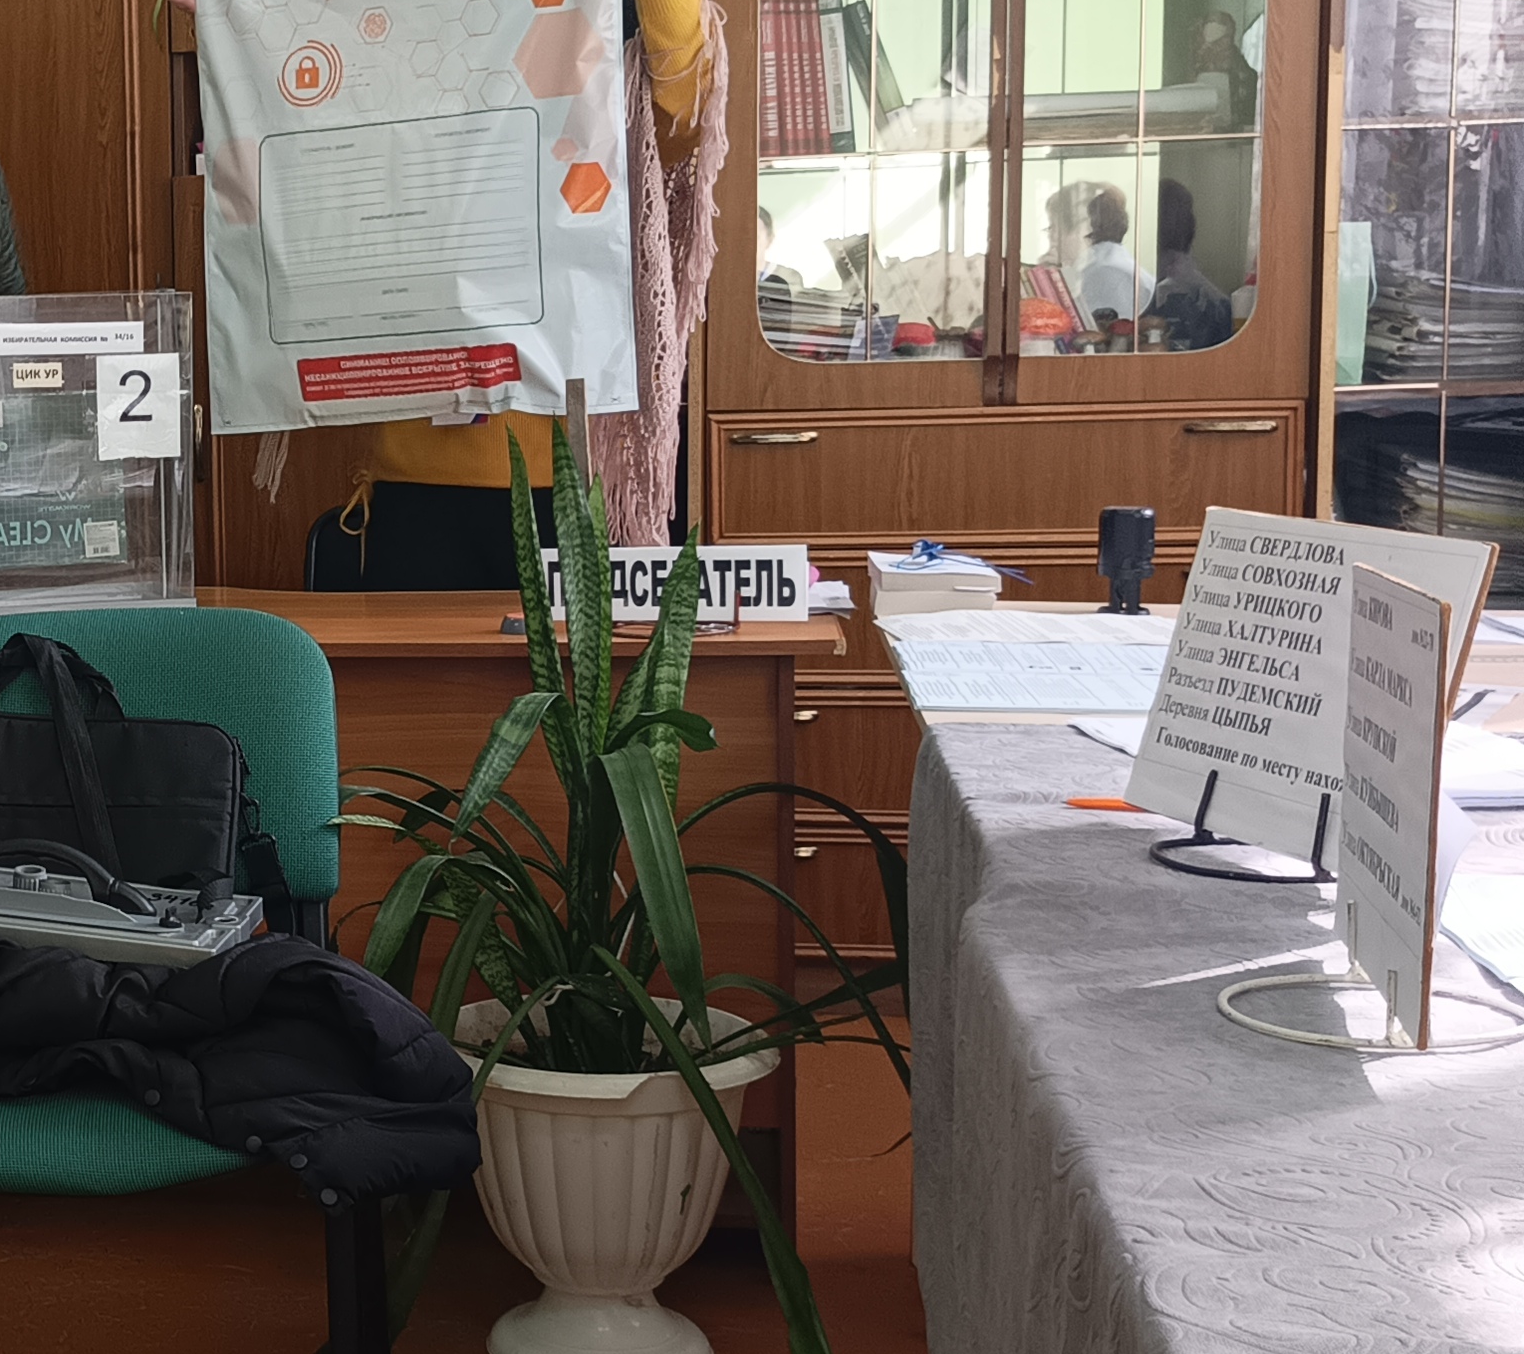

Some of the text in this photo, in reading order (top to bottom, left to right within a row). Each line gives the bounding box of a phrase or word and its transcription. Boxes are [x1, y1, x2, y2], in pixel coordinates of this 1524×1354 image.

[2, 336, 58, 344] ИЗБИРАТЕЛЬНАЯ
[60, 335, 97, 343] КОМИССИЯ
[16, 368, 59, 381] ЦИК УР
[119, 369, 153, 422] 2
[1208, 530, 1345, 566] Улица СВЕРДЛОВА
[547, 559, 796, 607] ПДСЕАТЕЛЬ
[1200, 557, 1342, 595] Улица СОВХОЗНАЯ
[1192, 584, 1323, 624] Улица УРИЦКОГО
[1183, 611, 1222, 636] Улица
[1223, 619, 1323, 655] ХАЛТУРИНА
[1175, 639, 1214, 664] Улица
[1217, 647, 1300, 682] ЭНГЕЛЬСА
[1167, 666, 1214, 694] Разъезд
[1216, 677, 1323, 717] ПУДЕМСКИЙ
[1158, 693, 1272, 736] Деревня ЦЫПЬЯ
[1155, 726, 1239, 764] Голосование
[1240, 753, 1258, 769] по
[1259, 758, 1302, 785] месту
